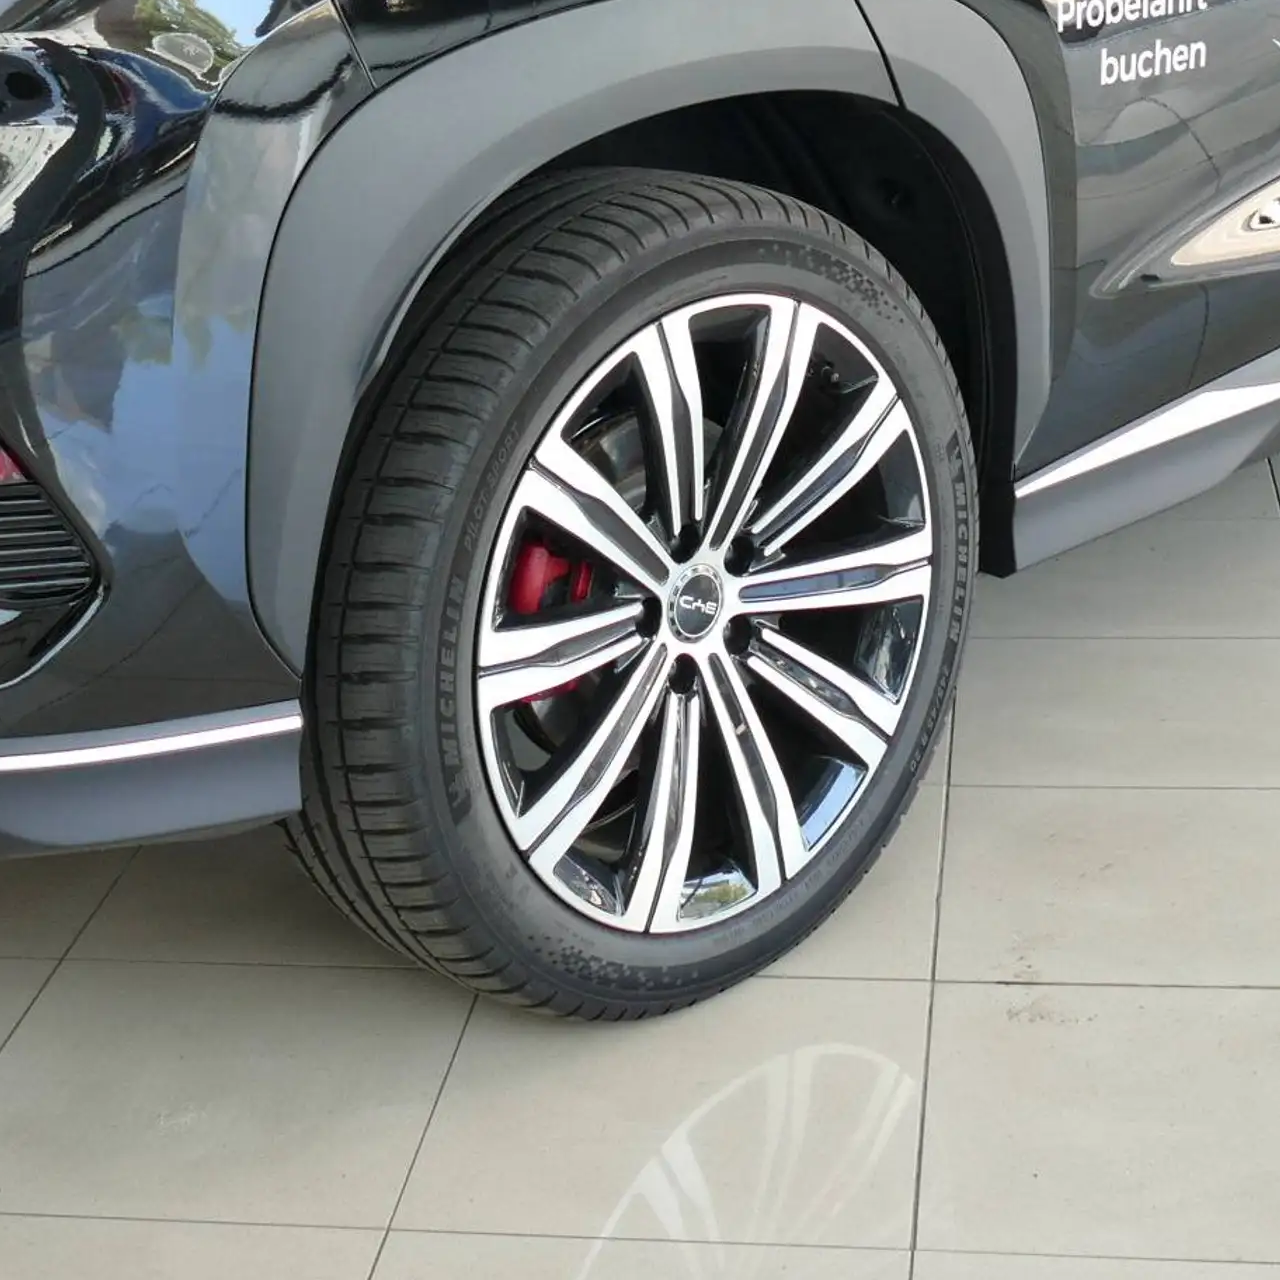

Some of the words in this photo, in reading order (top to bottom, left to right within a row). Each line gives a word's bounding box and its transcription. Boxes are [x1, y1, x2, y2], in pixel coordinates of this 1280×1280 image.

[1100, 38, 1207, 86] buchen
[948, 481, 969, 644] MICHELIN
[439, 573, 466, 770] MICHELIN
